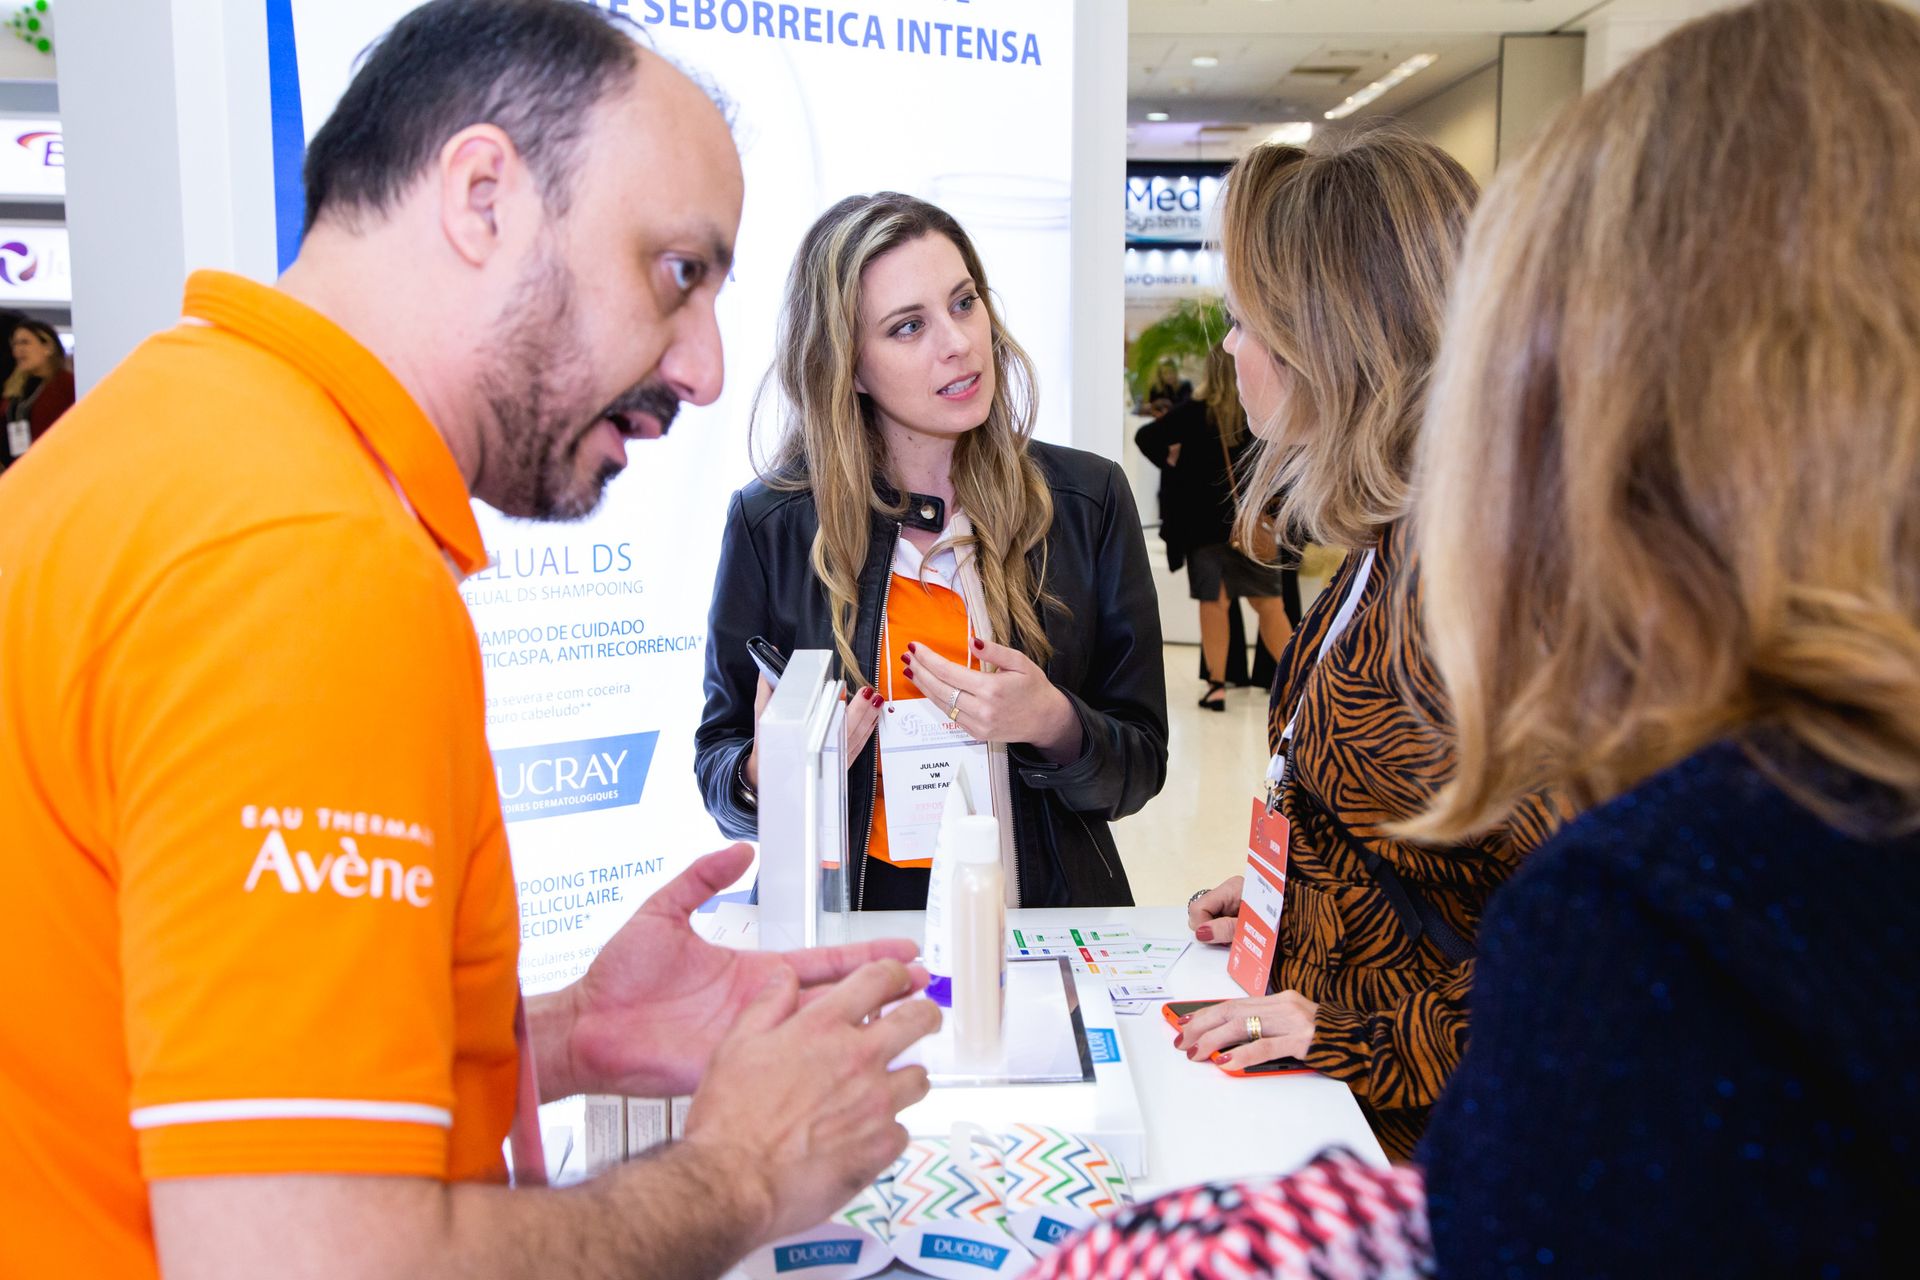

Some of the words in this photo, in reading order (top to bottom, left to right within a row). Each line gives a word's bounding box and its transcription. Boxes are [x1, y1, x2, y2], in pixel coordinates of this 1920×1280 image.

[643, 0, 886, 50] SEBORREICA
[897, 18, 1042, 66] INTENSA
[1126, 175, 1200, 212] Med
[467, 546, 579, 582] LUAL
[592, 542, 633, 574] DS
[463, 588, 513, 606] ELUAL
[517, 586, 538, 603] DS
[541, 580, 645, 600] SHAMPOOING
[478, 626, 543, 649] AMPOO
[546, 624, 568, 642] DE
[571, 619, 645, 641] CUIDADO
[483, 648, 554, 670] TICASPA,
[557, 644, 594, 663] ANTI
[502, 691, 543, 706] severa
[546, 690, 554, 702] e
[557, 688, 584, 701] com
[587, 682, 631, 698] coceira
[485, 711, 518, 725] ouro
[497, 749, 628, 799] UCRAY
[919, 761, 950, 770] JULIANA
[911, 782, 937, 791] PIERRE
[532, 789, 619, 811] DERMATOLOGIQUES
[240, 804, 304, 830] EAU
[242, 828, 435, 908] Avène
[517, 871, 586, 897] POOING
[589, 857, 665, 882] TRAITANT
[520, 886, 624, 918] ELLICULAIRE,
[788, 1242, 852, 1265] DUCRAY
[933, 1238, 999, 1263] DUCRAY
